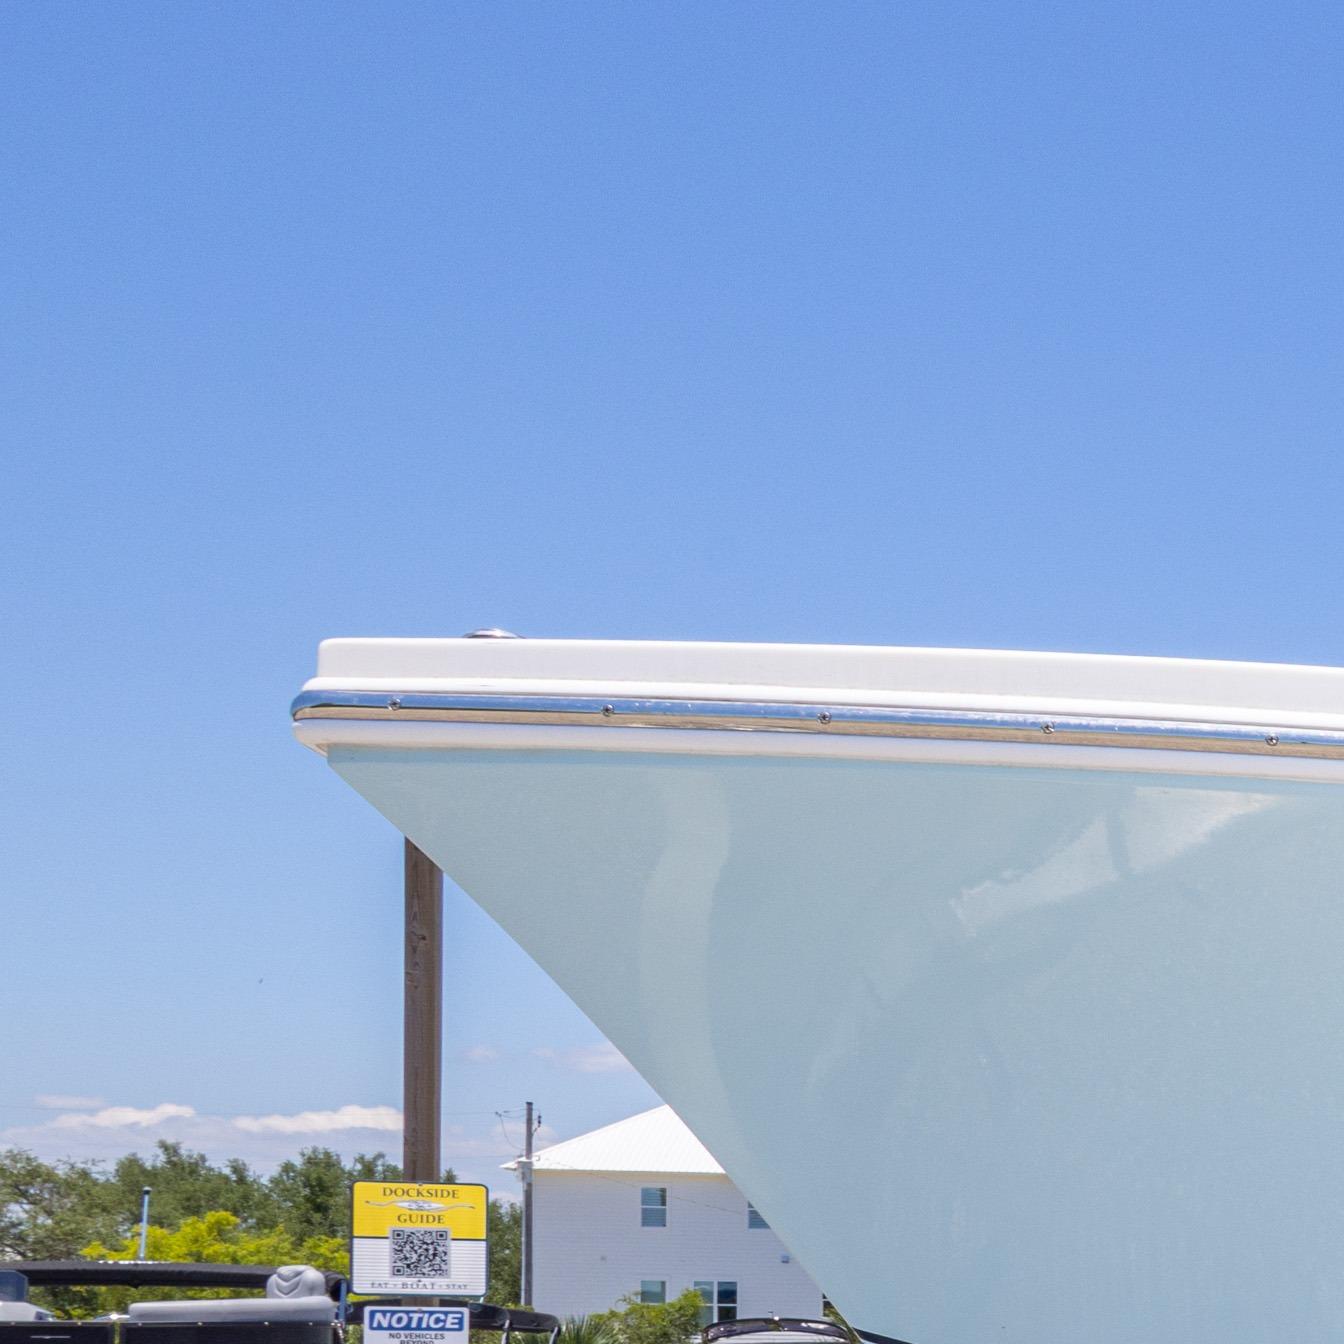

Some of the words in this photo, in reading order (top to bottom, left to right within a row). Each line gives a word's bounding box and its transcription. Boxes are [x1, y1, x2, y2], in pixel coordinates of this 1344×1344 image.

[382, 1187, 460, 1199] DOCKSIDE
[397, 1214, 445, 1224] GUIDE
[372, 1312, 462, 1329] NOTICE
